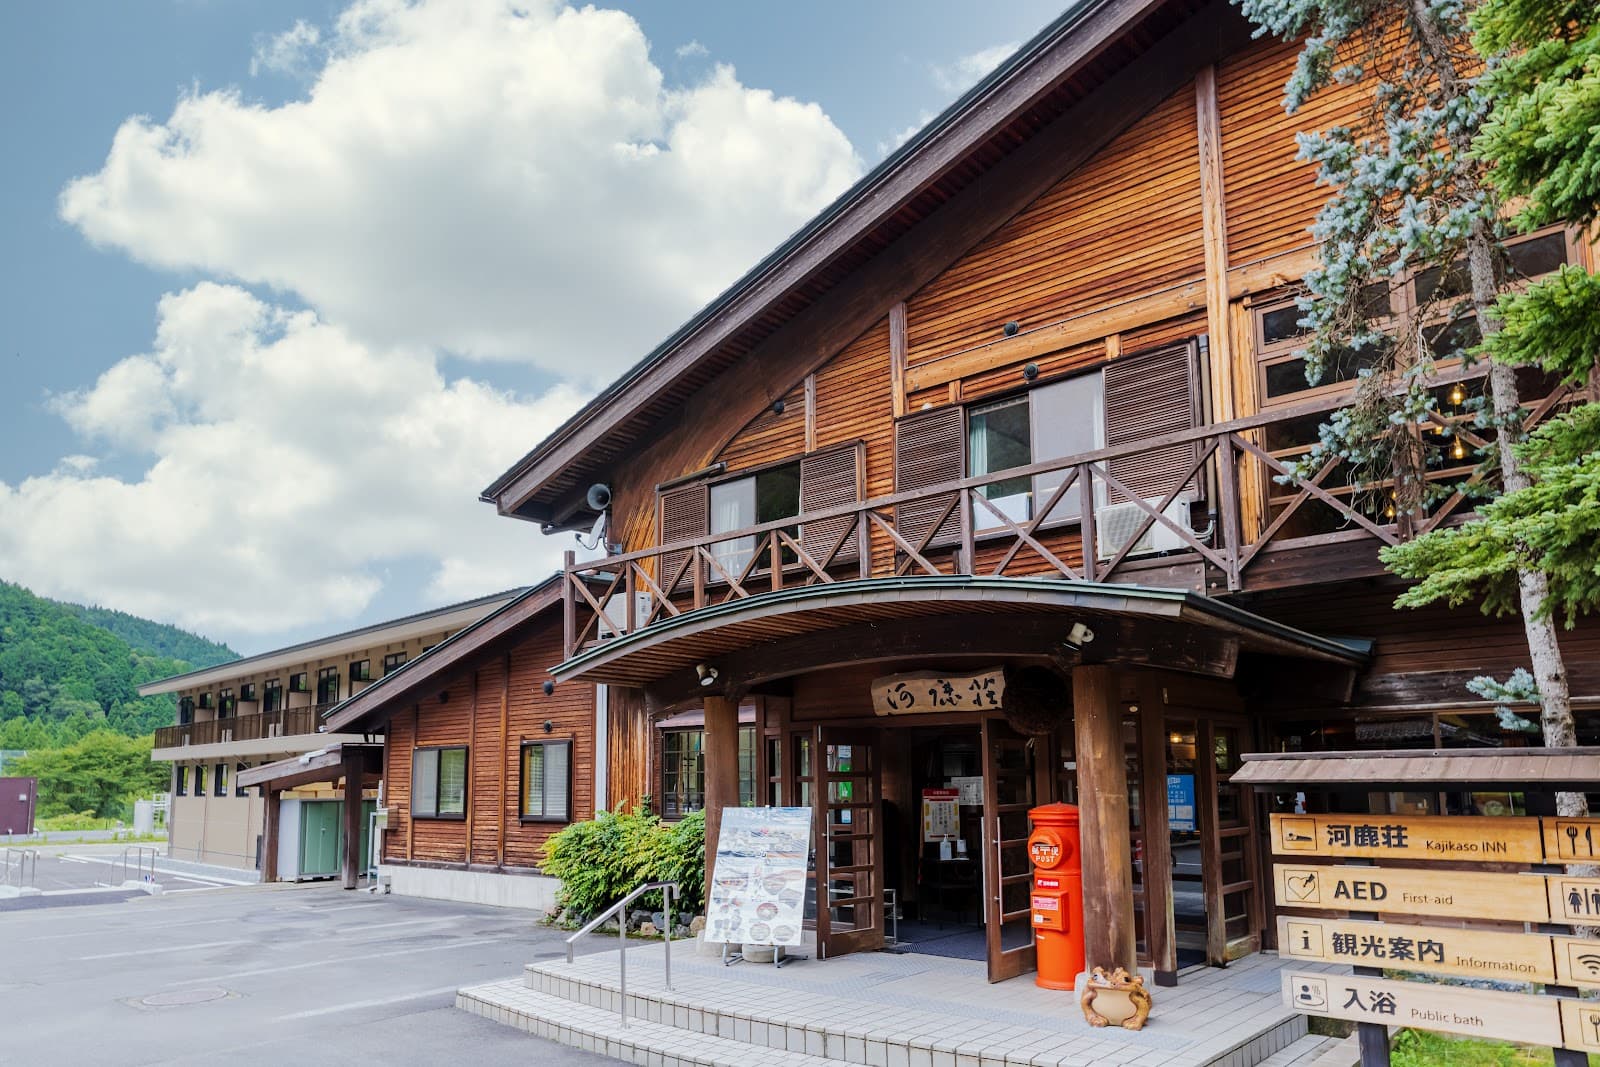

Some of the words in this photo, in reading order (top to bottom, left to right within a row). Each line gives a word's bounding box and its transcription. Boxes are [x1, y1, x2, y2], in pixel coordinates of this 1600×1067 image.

[1326, 824, 1408, 848] 河鹿荘
[1426, 840, 1478, 853] Kajikaso
[1482, 842, 1507, 853] INN
[1035, 855, 1055, 863] POST
[1334, 880, 1388, 901] AED
[1332, 932, 1445, 963] 観光案内
[1456, 956, 1537, 974] Information
[1343, 988, 1397, 1016] 入浴
[1411, 1008, 1449, 1023] Public
[1453, 1011, 1484, 1027] bath
